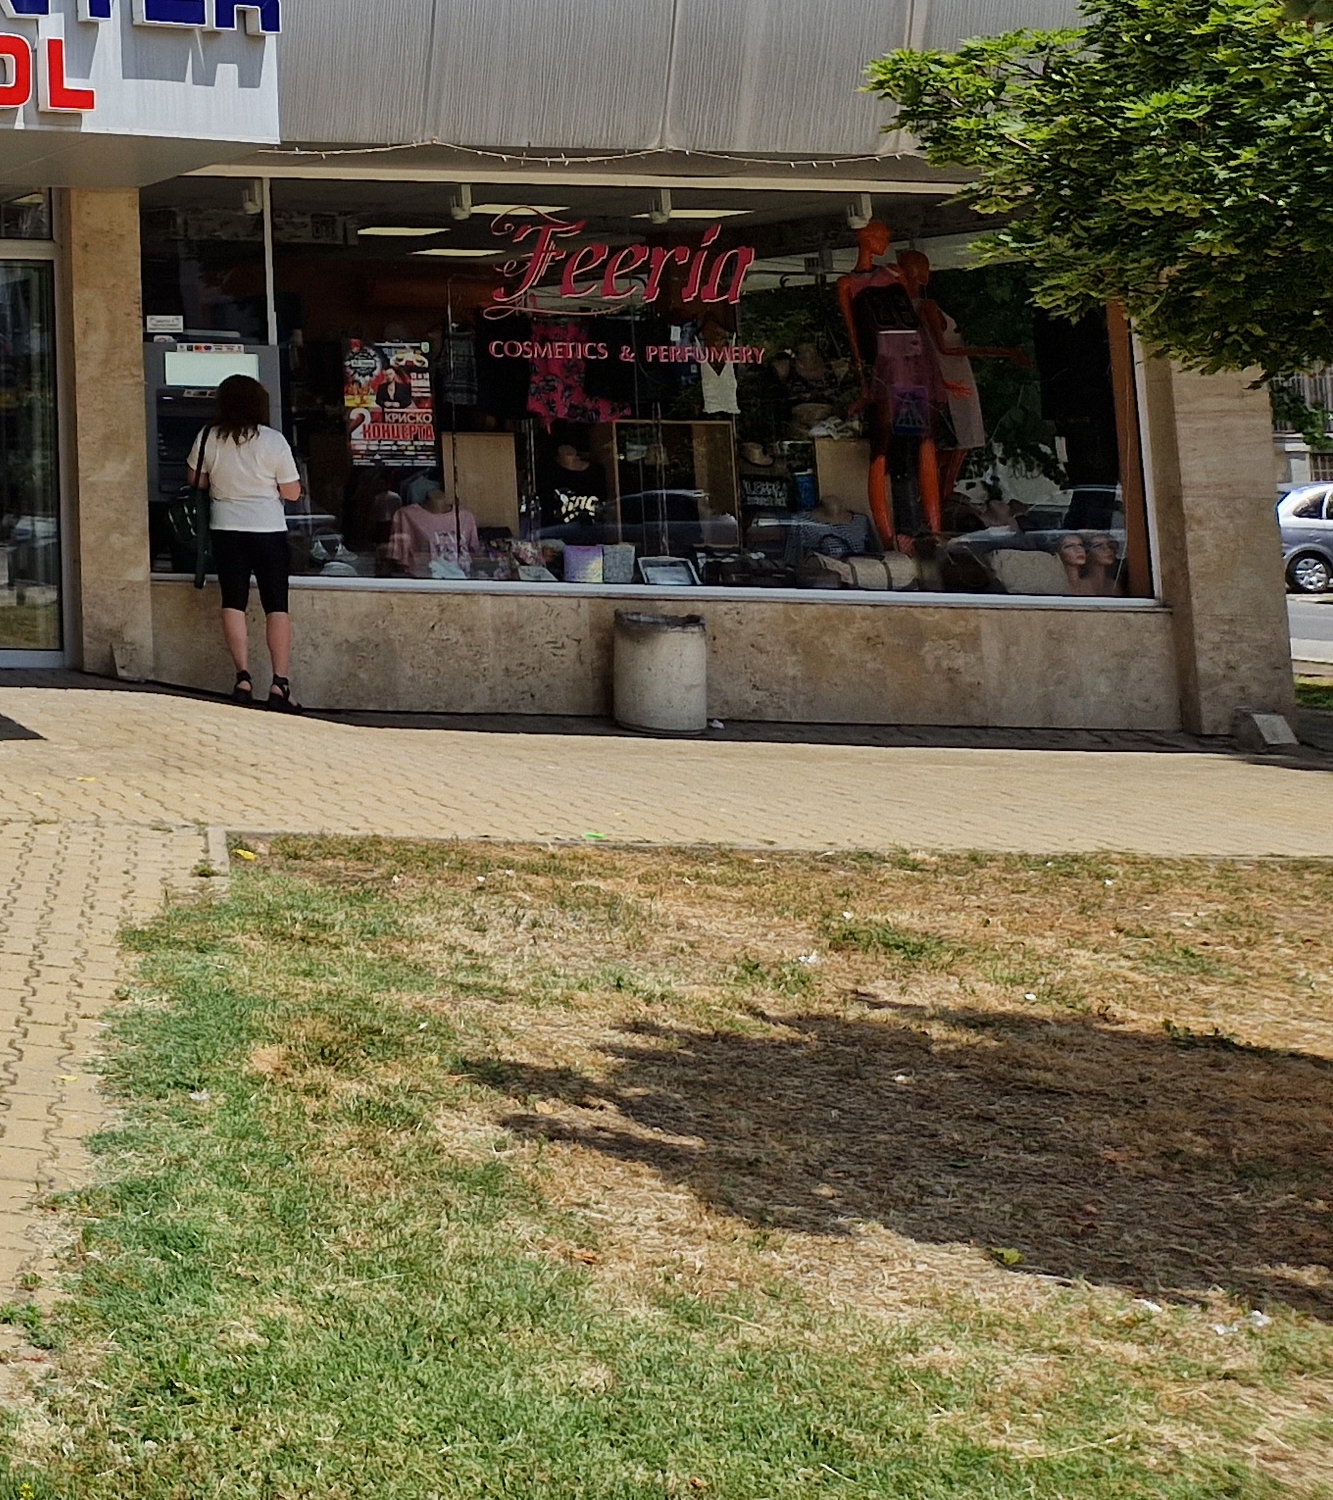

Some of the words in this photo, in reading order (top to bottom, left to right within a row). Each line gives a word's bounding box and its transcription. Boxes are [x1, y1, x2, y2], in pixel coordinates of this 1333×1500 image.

[488, 340, 609, 361] COSMETICS
[619, 345, 636, 363] &
[646, 345, 765, 365] PERFUMERY
[349, 407, 372, 440] 2
[384, 412, 433, 424] КРИСКО
[362, 423, 436, 441] КОНЦЕРТА
